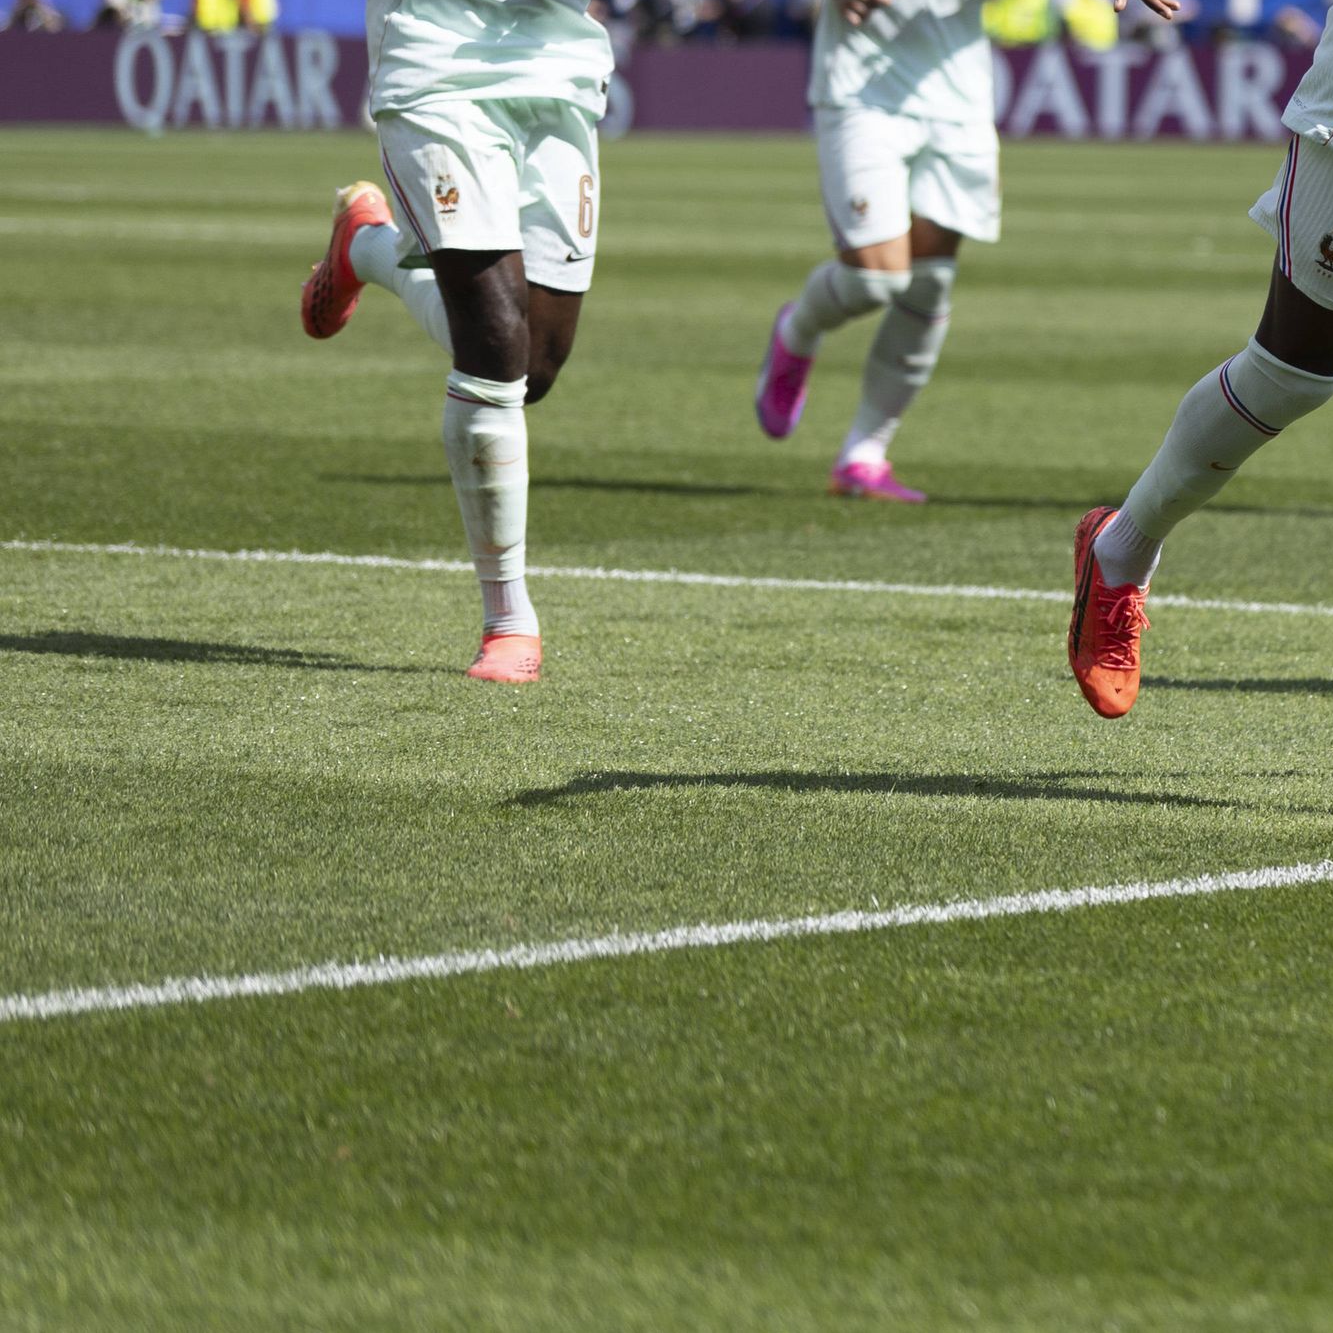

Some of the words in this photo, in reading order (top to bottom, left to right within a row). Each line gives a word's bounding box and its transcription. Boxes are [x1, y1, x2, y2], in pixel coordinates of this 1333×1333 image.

[114, 24, 342, 139] QATAR
[993, 38, 1285, 143] ATAR
[578, 174, 594, 239] 6
